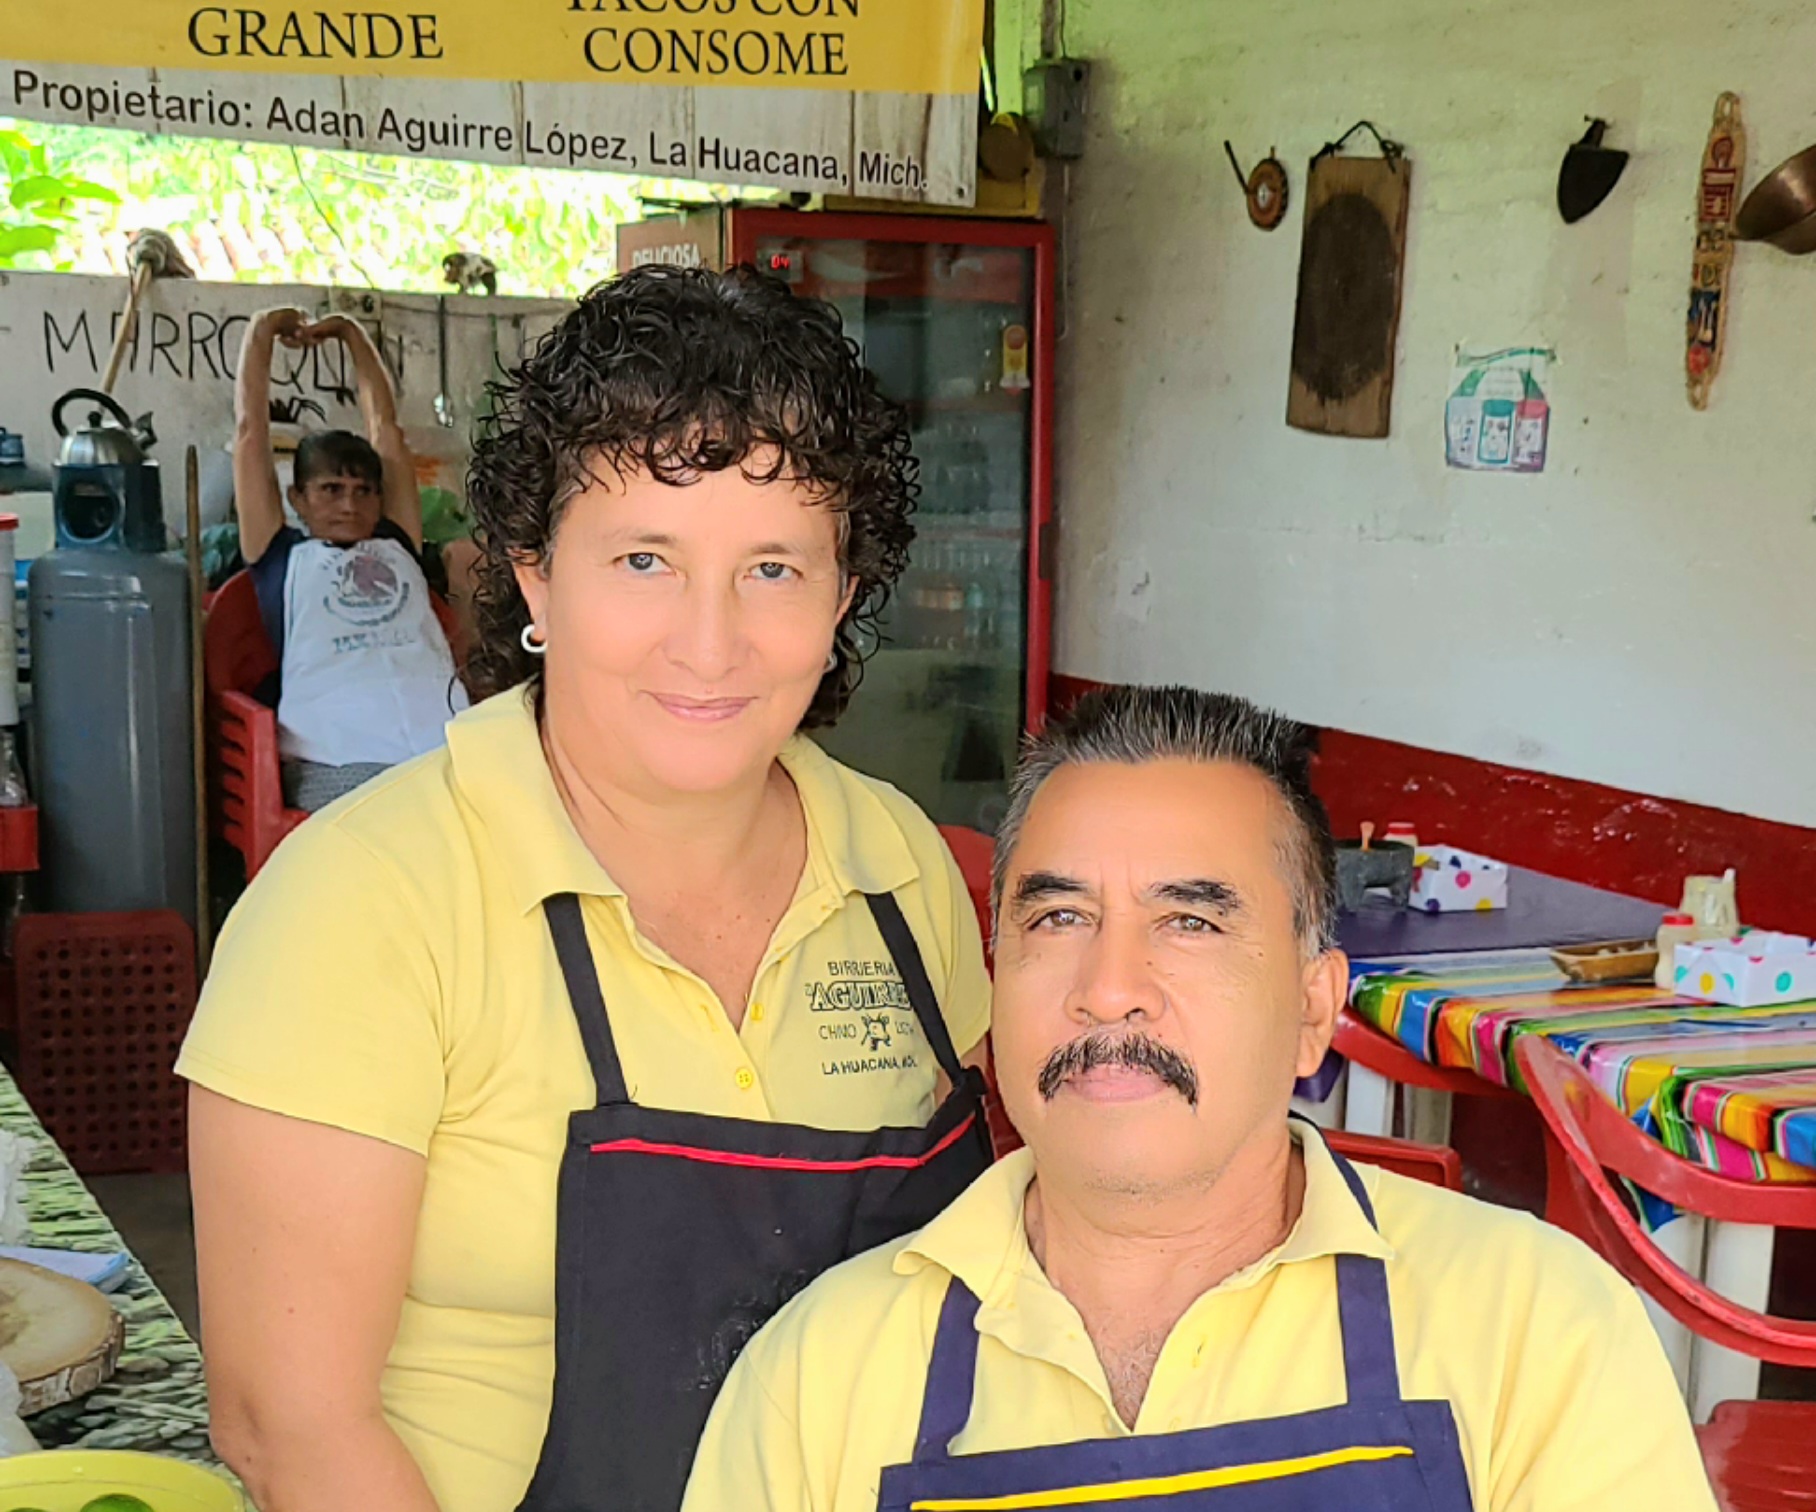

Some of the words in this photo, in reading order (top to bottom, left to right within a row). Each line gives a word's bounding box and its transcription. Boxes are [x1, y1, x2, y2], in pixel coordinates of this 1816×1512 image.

[188, 7, 444, 59] GRANDE
[584, 27, 848, 75] CONSOME
[13, 69, 252, 128] Propietario:
[266, 96, 365, 139] Adan
[377, 107, 513, 152] Aguirre
[525, 121, 638, 169] López,
[649, 131, 687, 166] La
[698, 135, 848, 186] Huacana,
[859, 150, 929, 188] Mich.
